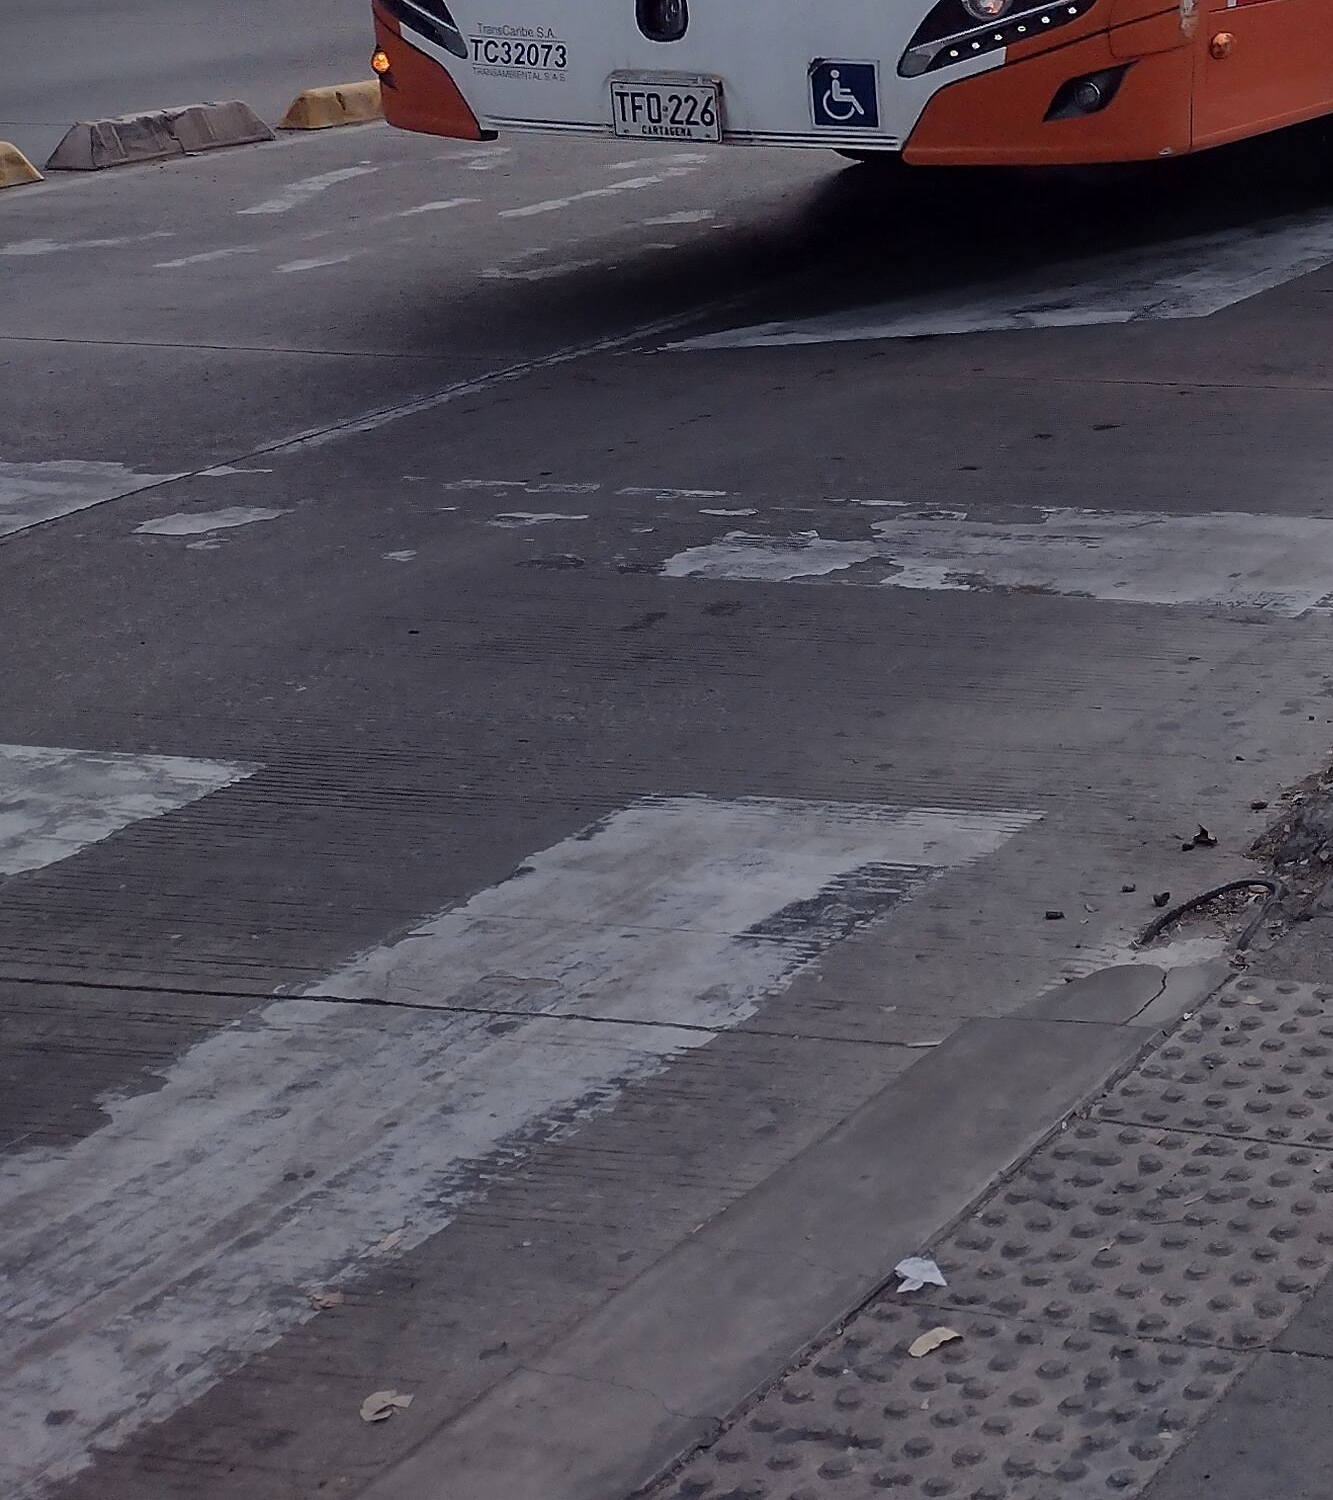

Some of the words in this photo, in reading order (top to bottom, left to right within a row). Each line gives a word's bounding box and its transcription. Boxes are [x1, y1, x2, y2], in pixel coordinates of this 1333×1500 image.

[477, 22, 534, 37] TransCaribe
[470, 38, 567, 69] TC32073
[641, 124, 692, 137] CARTAGENA
